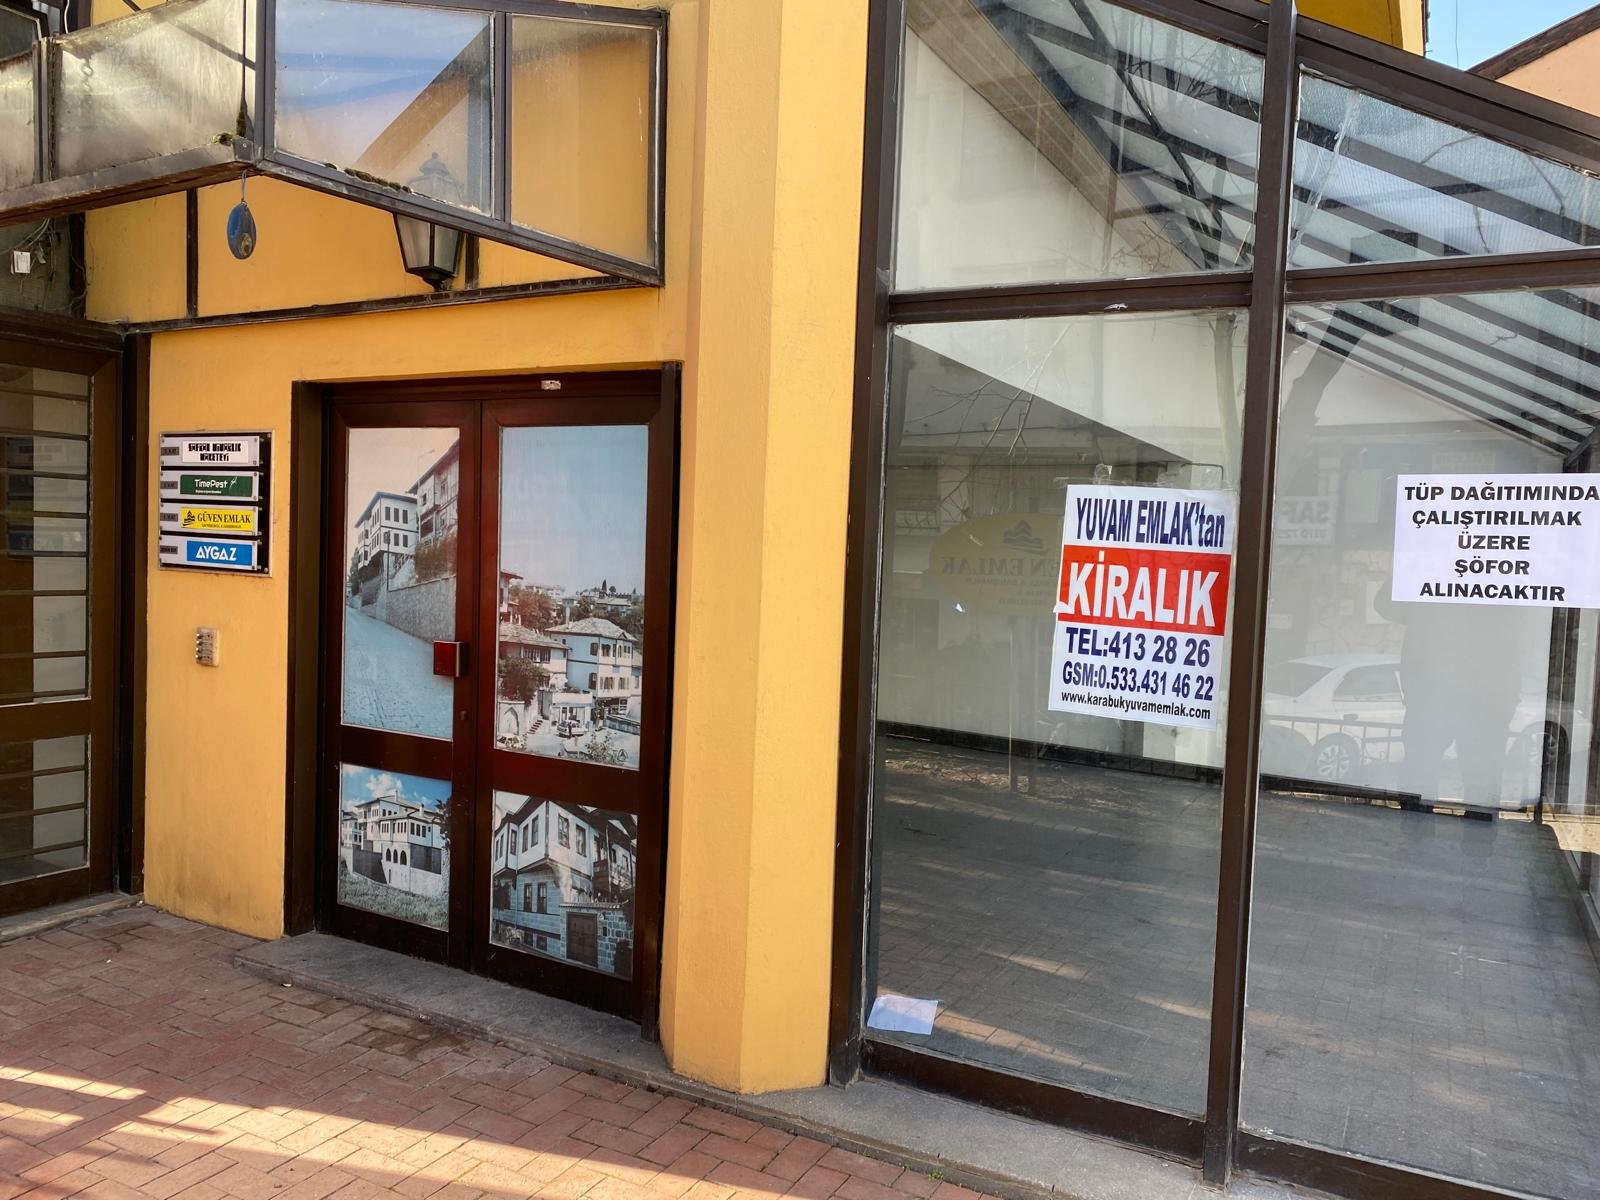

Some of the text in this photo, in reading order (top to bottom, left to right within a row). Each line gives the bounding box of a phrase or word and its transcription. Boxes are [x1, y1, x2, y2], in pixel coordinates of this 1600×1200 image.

[1405, 481, 1600, 501] TÜP DAĞITIMINDA
[197, 511, 251, 524] GÜVEN EMLAK
[1076, 497, 1225, 548] YUVAM EMLAK'tan
[1412, 510, 1582, 529] ÇALIŞTIRILMAK
[1458, 531, 1531, 550] ÜZERE
[195, 545, 237, 561] AYGAZ
[1454, 555, 1530, 578] ŞÖFOR
[1069, 550, 1220, 627] KİRALIK
[1419, 582, 1565, 601] ALINACAKTIR
[1066, 626, 1211, 667] TEL:413 28 26
[1062, 661, 1214, 701] GSM:0.533.431 46 22
[1061, 691, 1211, 720] www.karabukyuvamemlak.com
